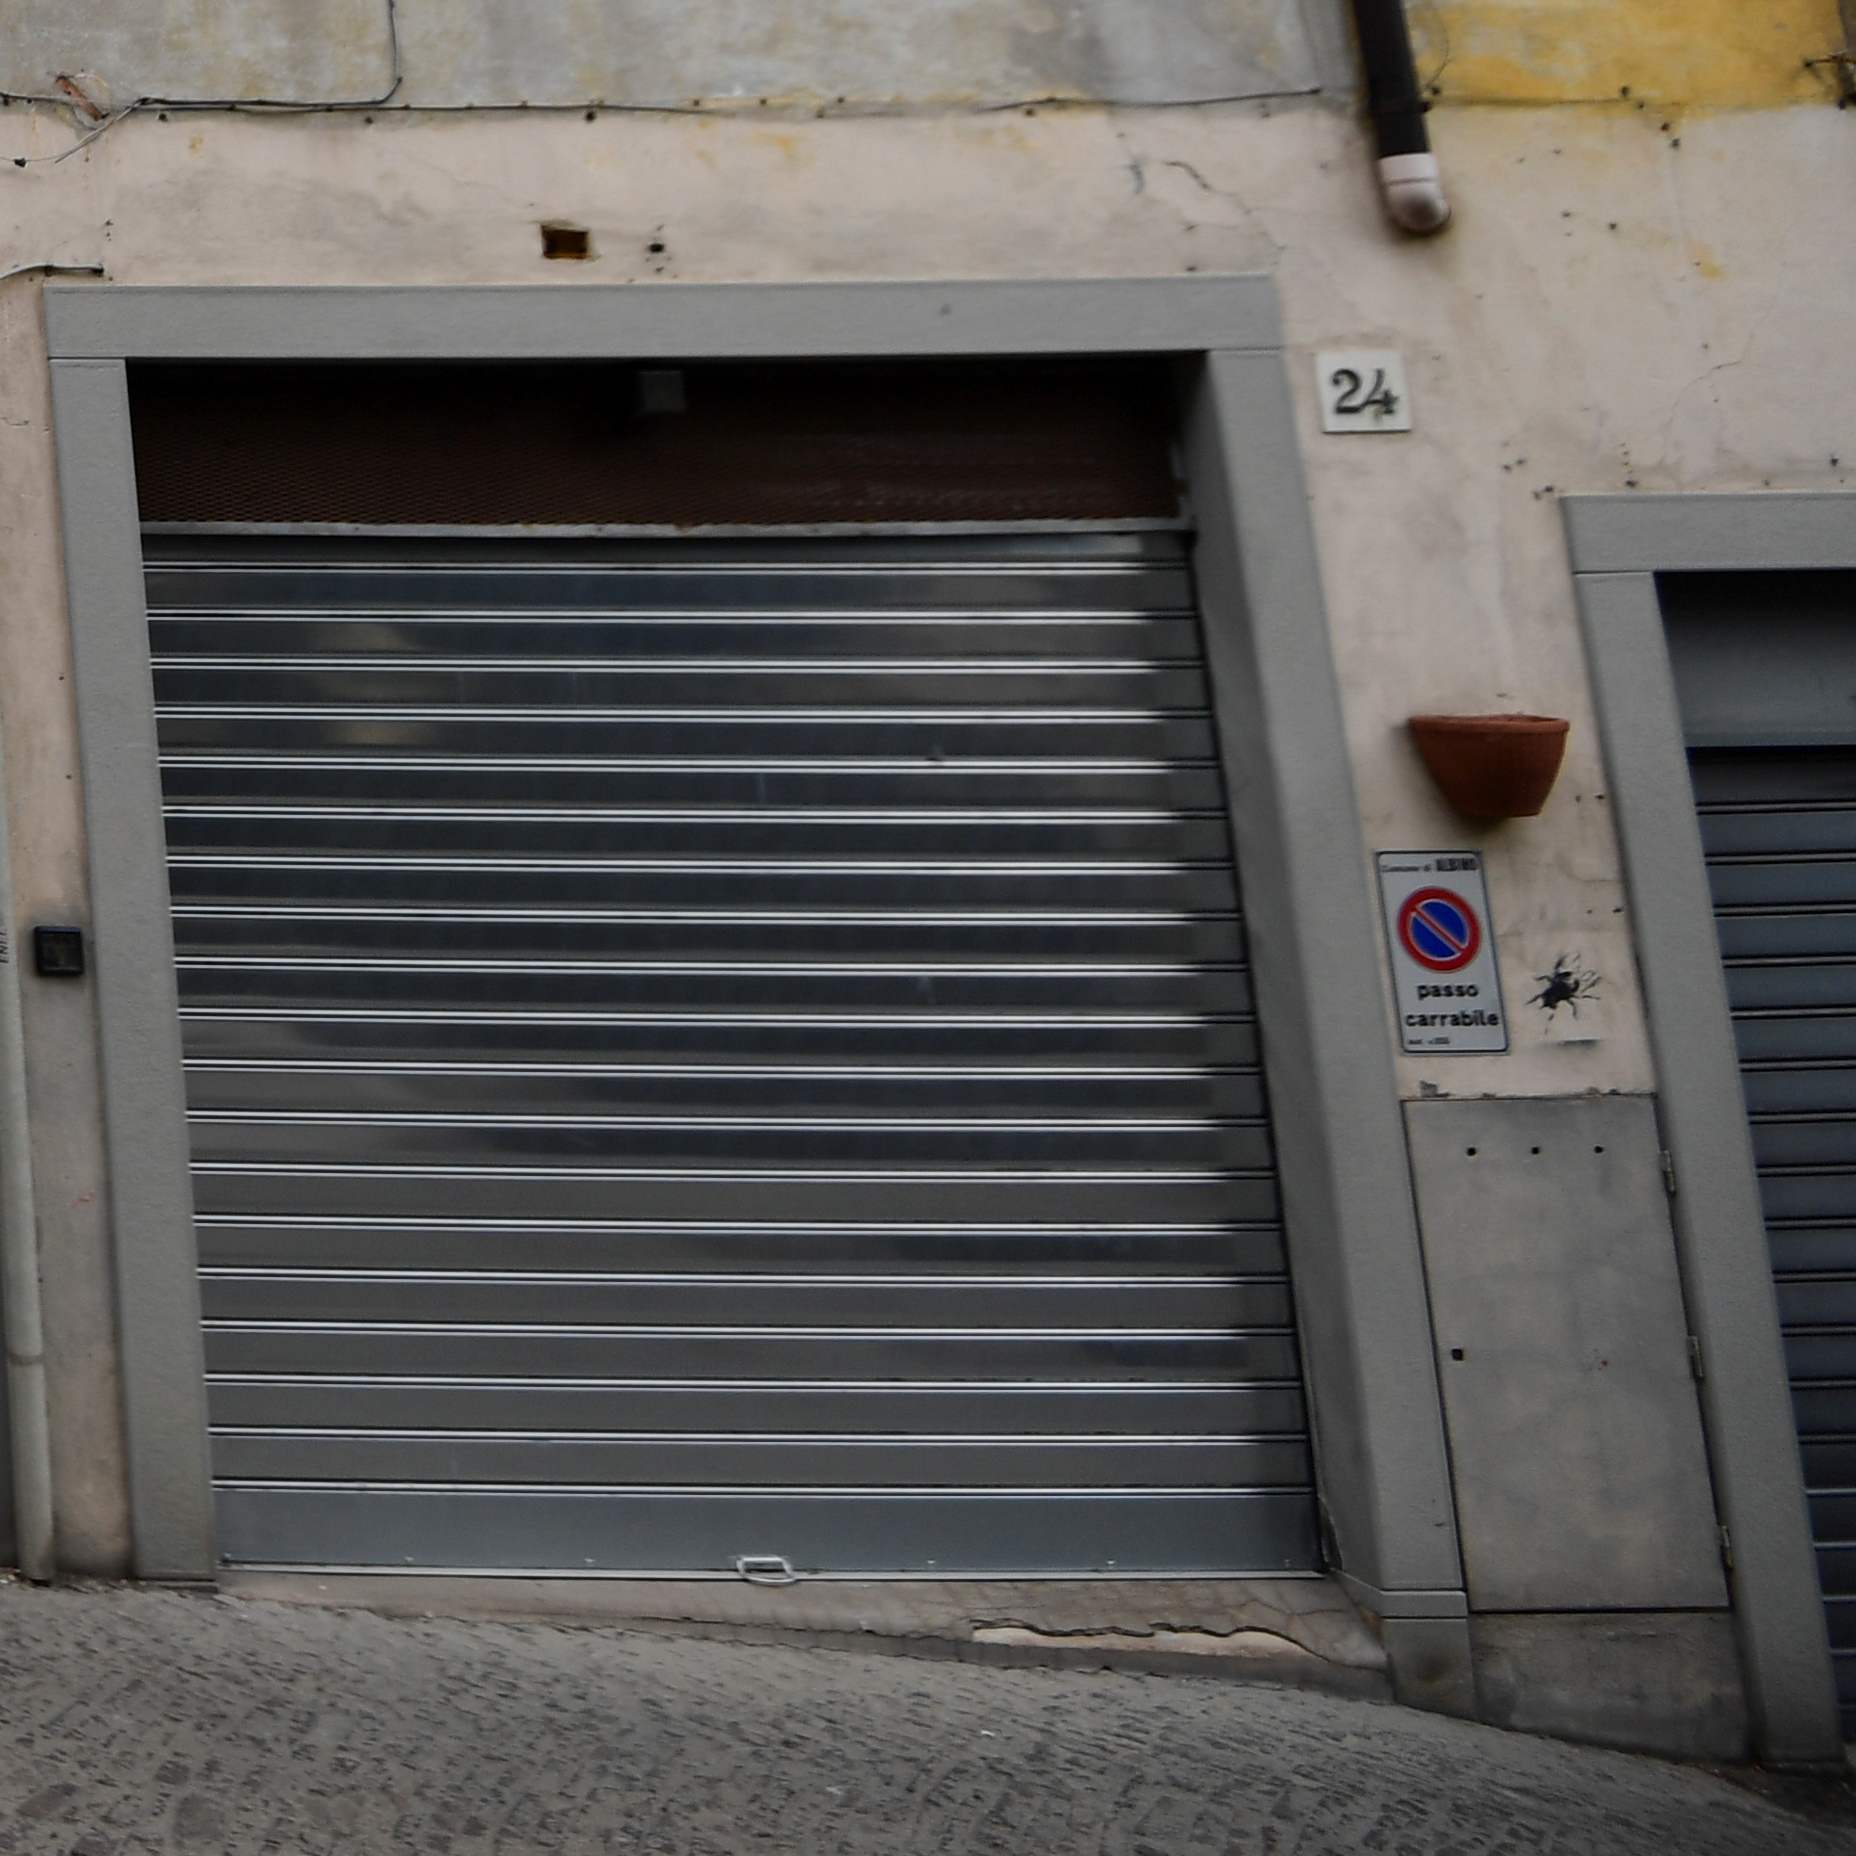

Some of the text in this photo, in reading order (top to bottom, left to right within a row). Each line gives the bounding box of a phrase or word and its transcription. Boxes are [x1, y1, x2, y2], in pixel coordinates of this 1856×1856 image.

[1331, 368, 1400, 415] 24
[1417, 984, 1479, 1001] passo
[1405, 1010, 1500, 1027] carrabile
